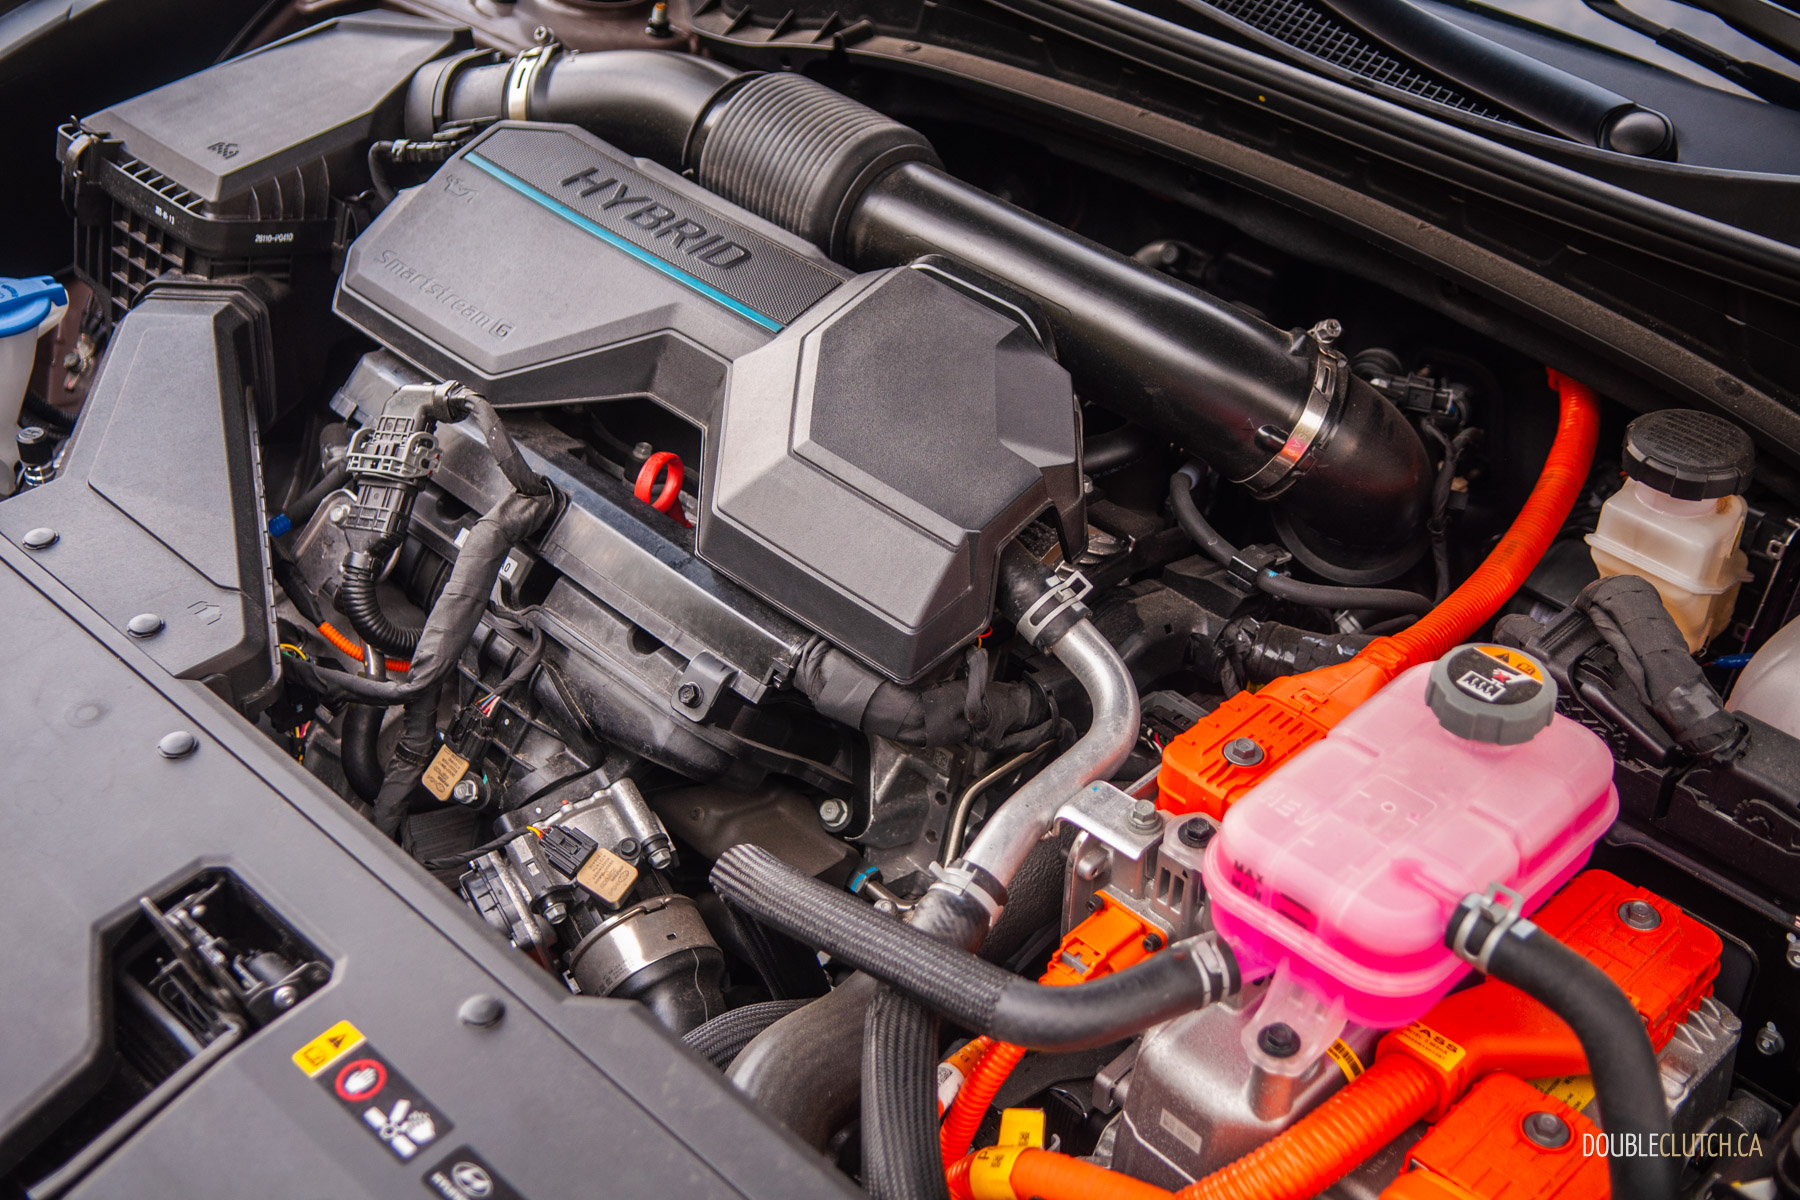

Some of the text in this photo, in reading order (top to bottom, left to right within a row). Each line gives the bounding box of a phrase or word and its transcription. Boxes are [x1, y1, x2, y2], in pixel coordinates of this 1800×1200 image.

[559, 166, 751, 270] HYBRID
[374, 249, 494, 328] Smartstream
[1232, 876, 1262, 901] MIN
[1234, 860, 1264, 884] MAX
